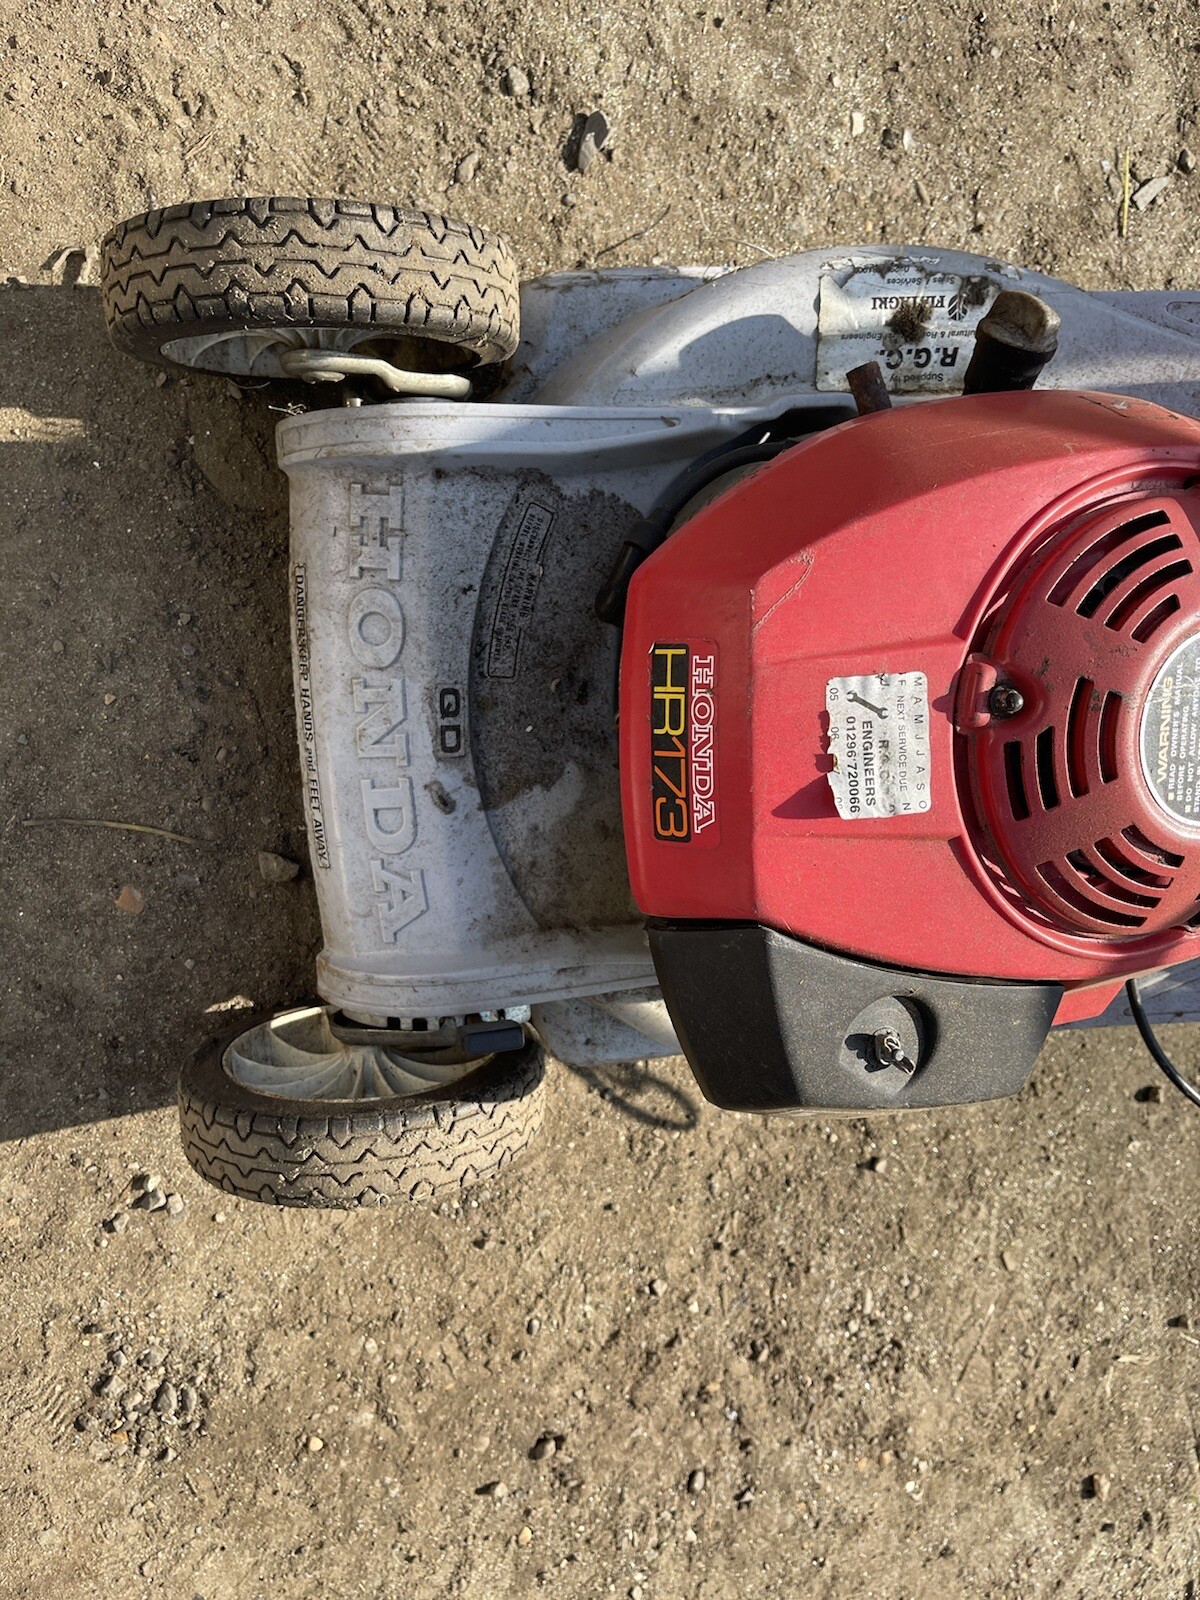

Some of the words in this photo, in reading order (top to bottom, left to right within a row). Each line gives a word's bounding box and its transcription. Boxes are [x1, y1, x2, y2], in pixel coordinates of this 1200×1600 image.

[886, 277, 922, 285] Services
[871, 295, 946, 310] FITAGRI
[840, 331, 882, 341] Engineers
[880, 347, 960, 370] R.G.C.
[295, 574, 307, 638] DANGER
[830, 687, 839, 701] 05
[913, 676, 922, 687] M
[1174, 662, 1184, 706] MANUAL
[348, 482, 428, 945] HONDA
[896, 695, 905, 721] NEXT
[914, 697, 922, 705] A
[300, 687, 314, 742] HANDS
[439, 687, 461, 755] QD
[914, 714, 924, 725] M
[652, 648, 688, 838] HR173
[830, 726, 840, 740] 06
[1156, 676, 1174, 784] WARNING
[1170, 711, 1180, 758] OWNER'S
[1180, 706, 1190, 759] OPERATING
[1188, 721, 1198, 756] ALLOW
[691, 655, 715, 834] HONDA
[898, 724, 907, 768] SERVICE
[304, 747, 316, 772] and
[862, 720, 876, 807] ENGINEERS
[916, 766, 926, 774] A
[1187, 762, 1195, 783] NOT
[899, 770, 908, 792] DUE
[916, 782, 926, 790] S
[1168, 763, 1176, 790] READ
[1176, 764, 1186, 802] BEFORE
[309, 778, 322, 813] FEET
[902, 802, 912, 811] N
[1186, 788, 1193, 802] DO
[313, 818, 328, 862] AWAY
